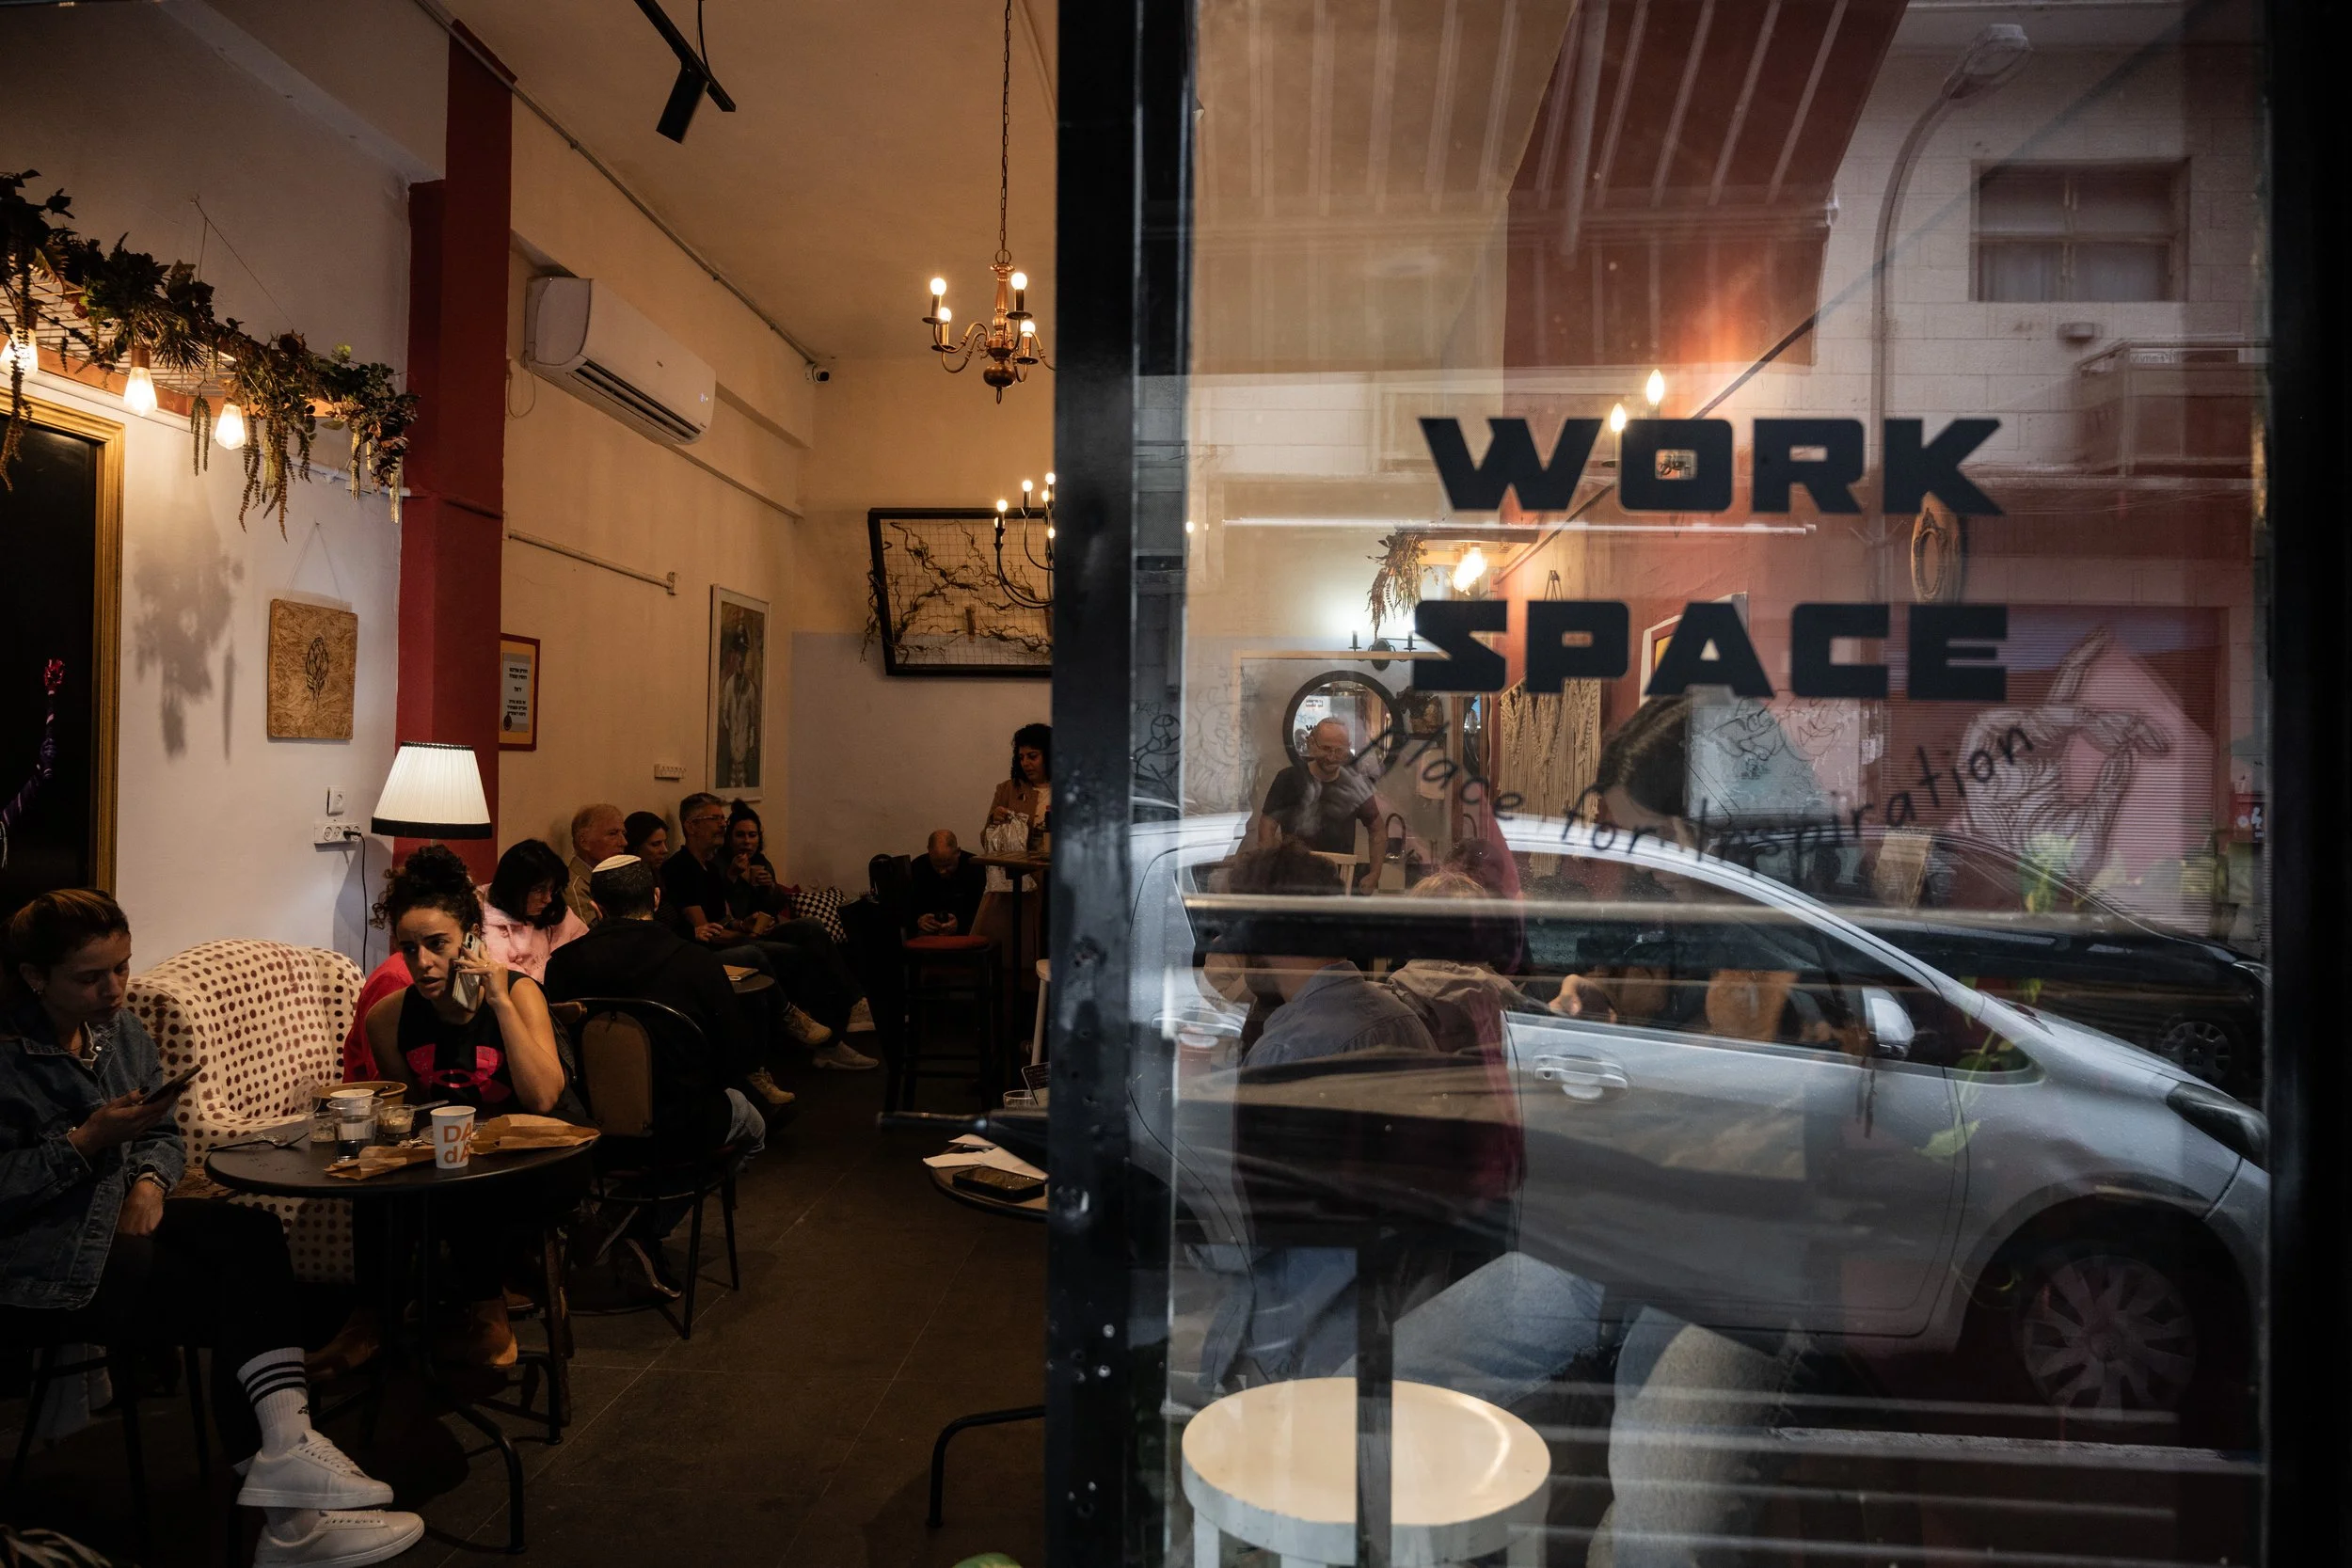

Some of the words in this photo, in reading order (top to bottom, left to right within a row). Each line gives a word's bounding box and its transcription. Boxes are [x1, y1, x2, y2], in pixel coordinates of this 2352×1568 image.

[1420, 418, 2006, 516] WORK
[1414, 599, 2008, 700] SPACE
[1346, 719, 1523, 820] Place
[1561, 782, 1658, 854] for
